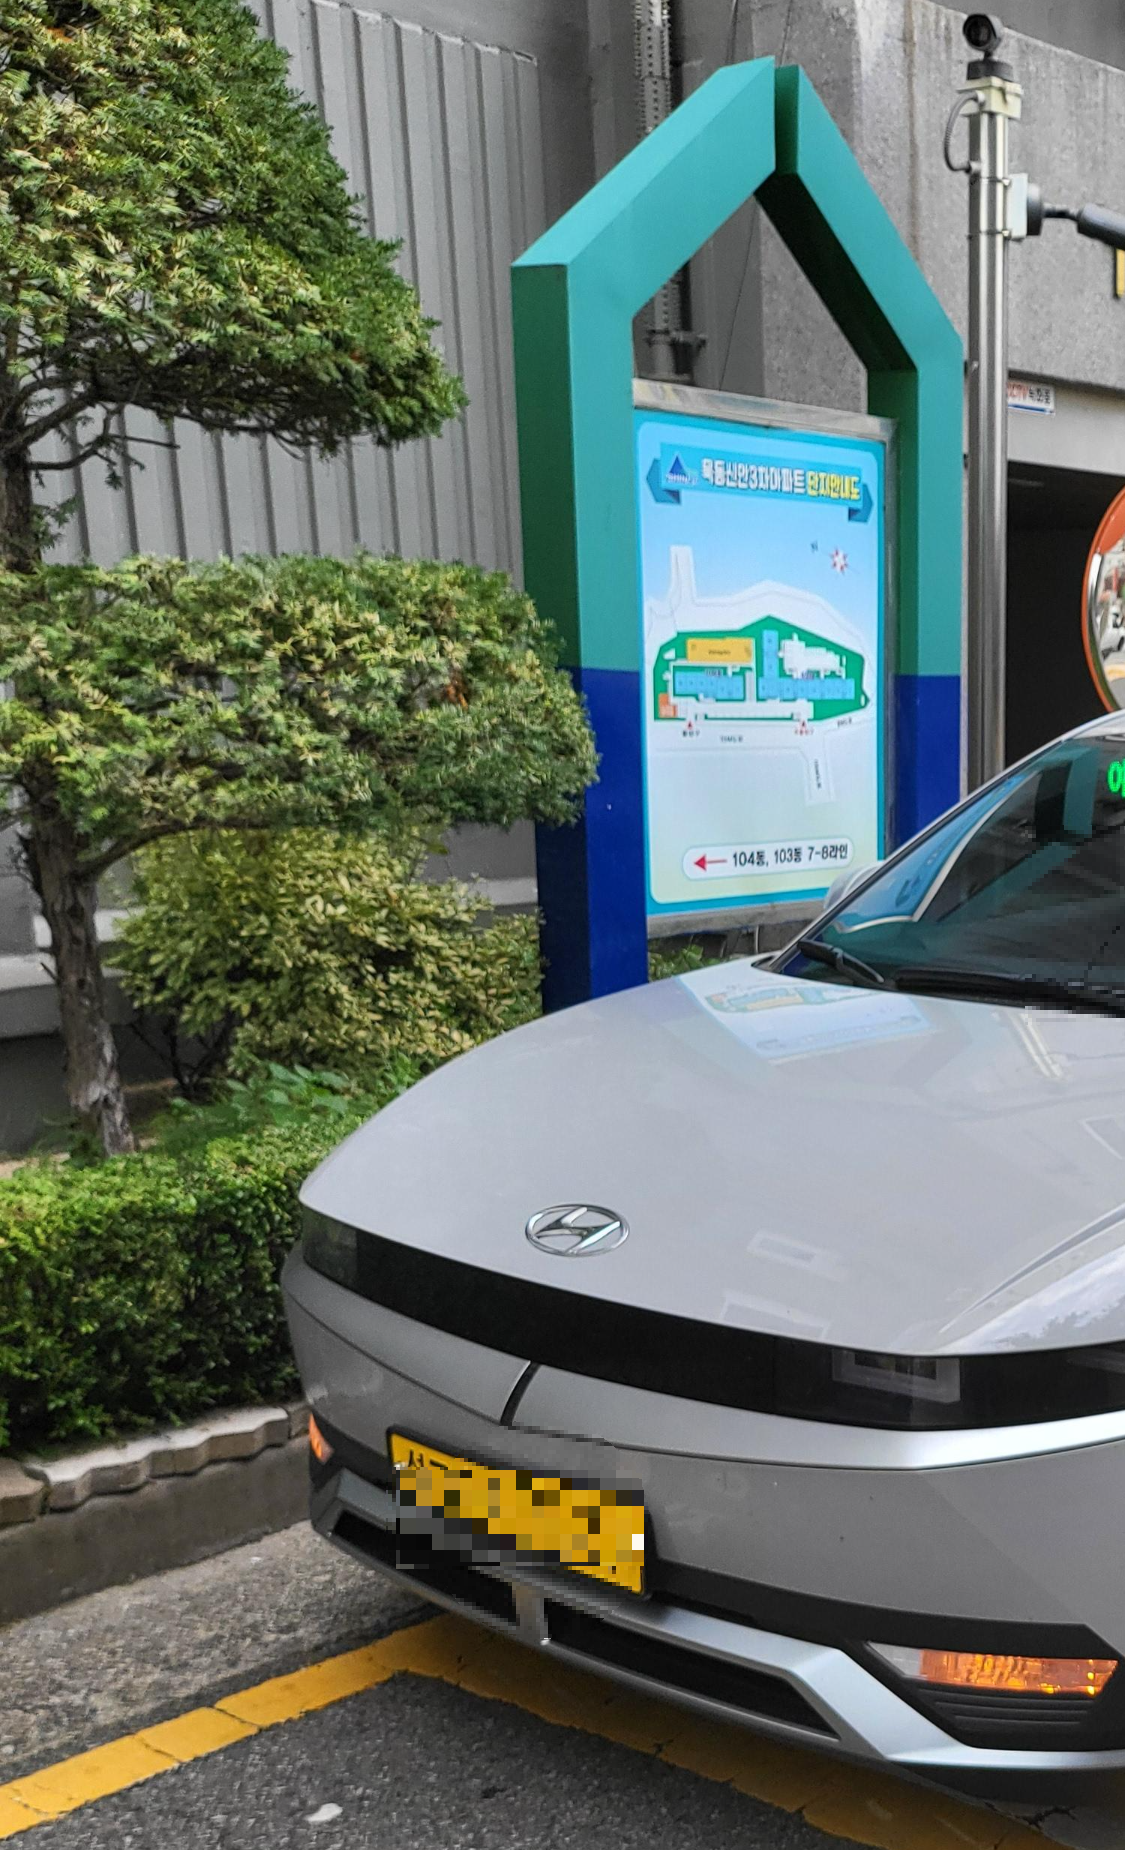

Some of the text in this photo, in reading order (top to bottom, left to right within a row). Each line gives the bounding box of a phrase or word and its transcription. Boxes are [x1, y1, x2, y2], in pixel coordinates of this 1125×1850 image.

[733, 843, 848, 867] 104동, 103동 7-8라인
